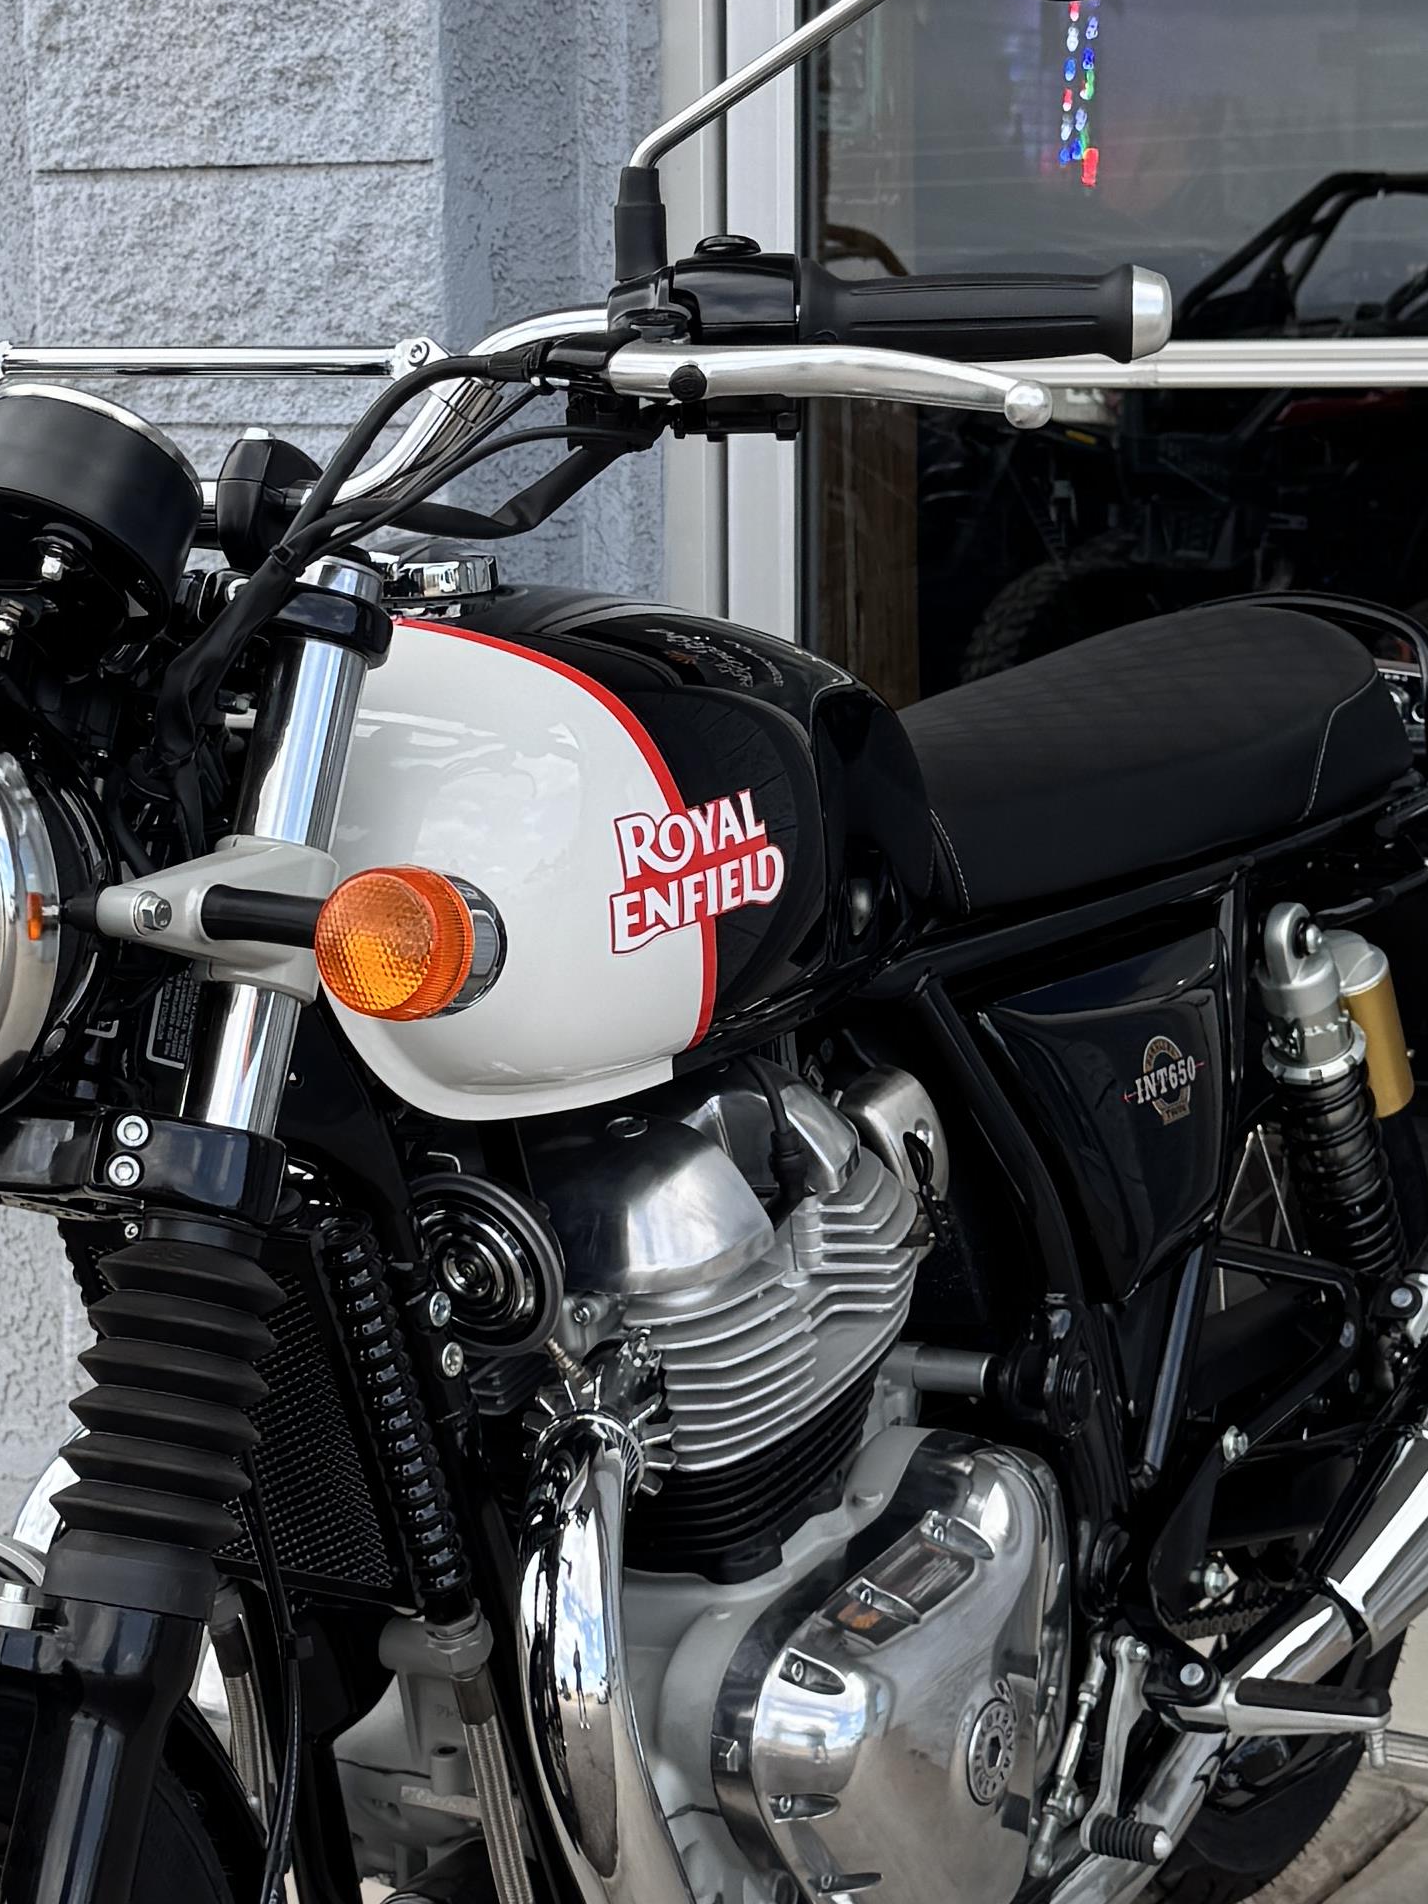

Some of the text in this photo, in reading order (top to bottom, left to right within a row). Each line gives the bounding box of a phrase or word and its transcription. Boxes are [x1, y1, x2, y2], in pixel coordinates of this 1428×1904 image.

[614, 788, 767, 880] ROYAL
[610, 844, 784, 954] ENFIELD
[1135, 1055, 1196, 1104] INT650
